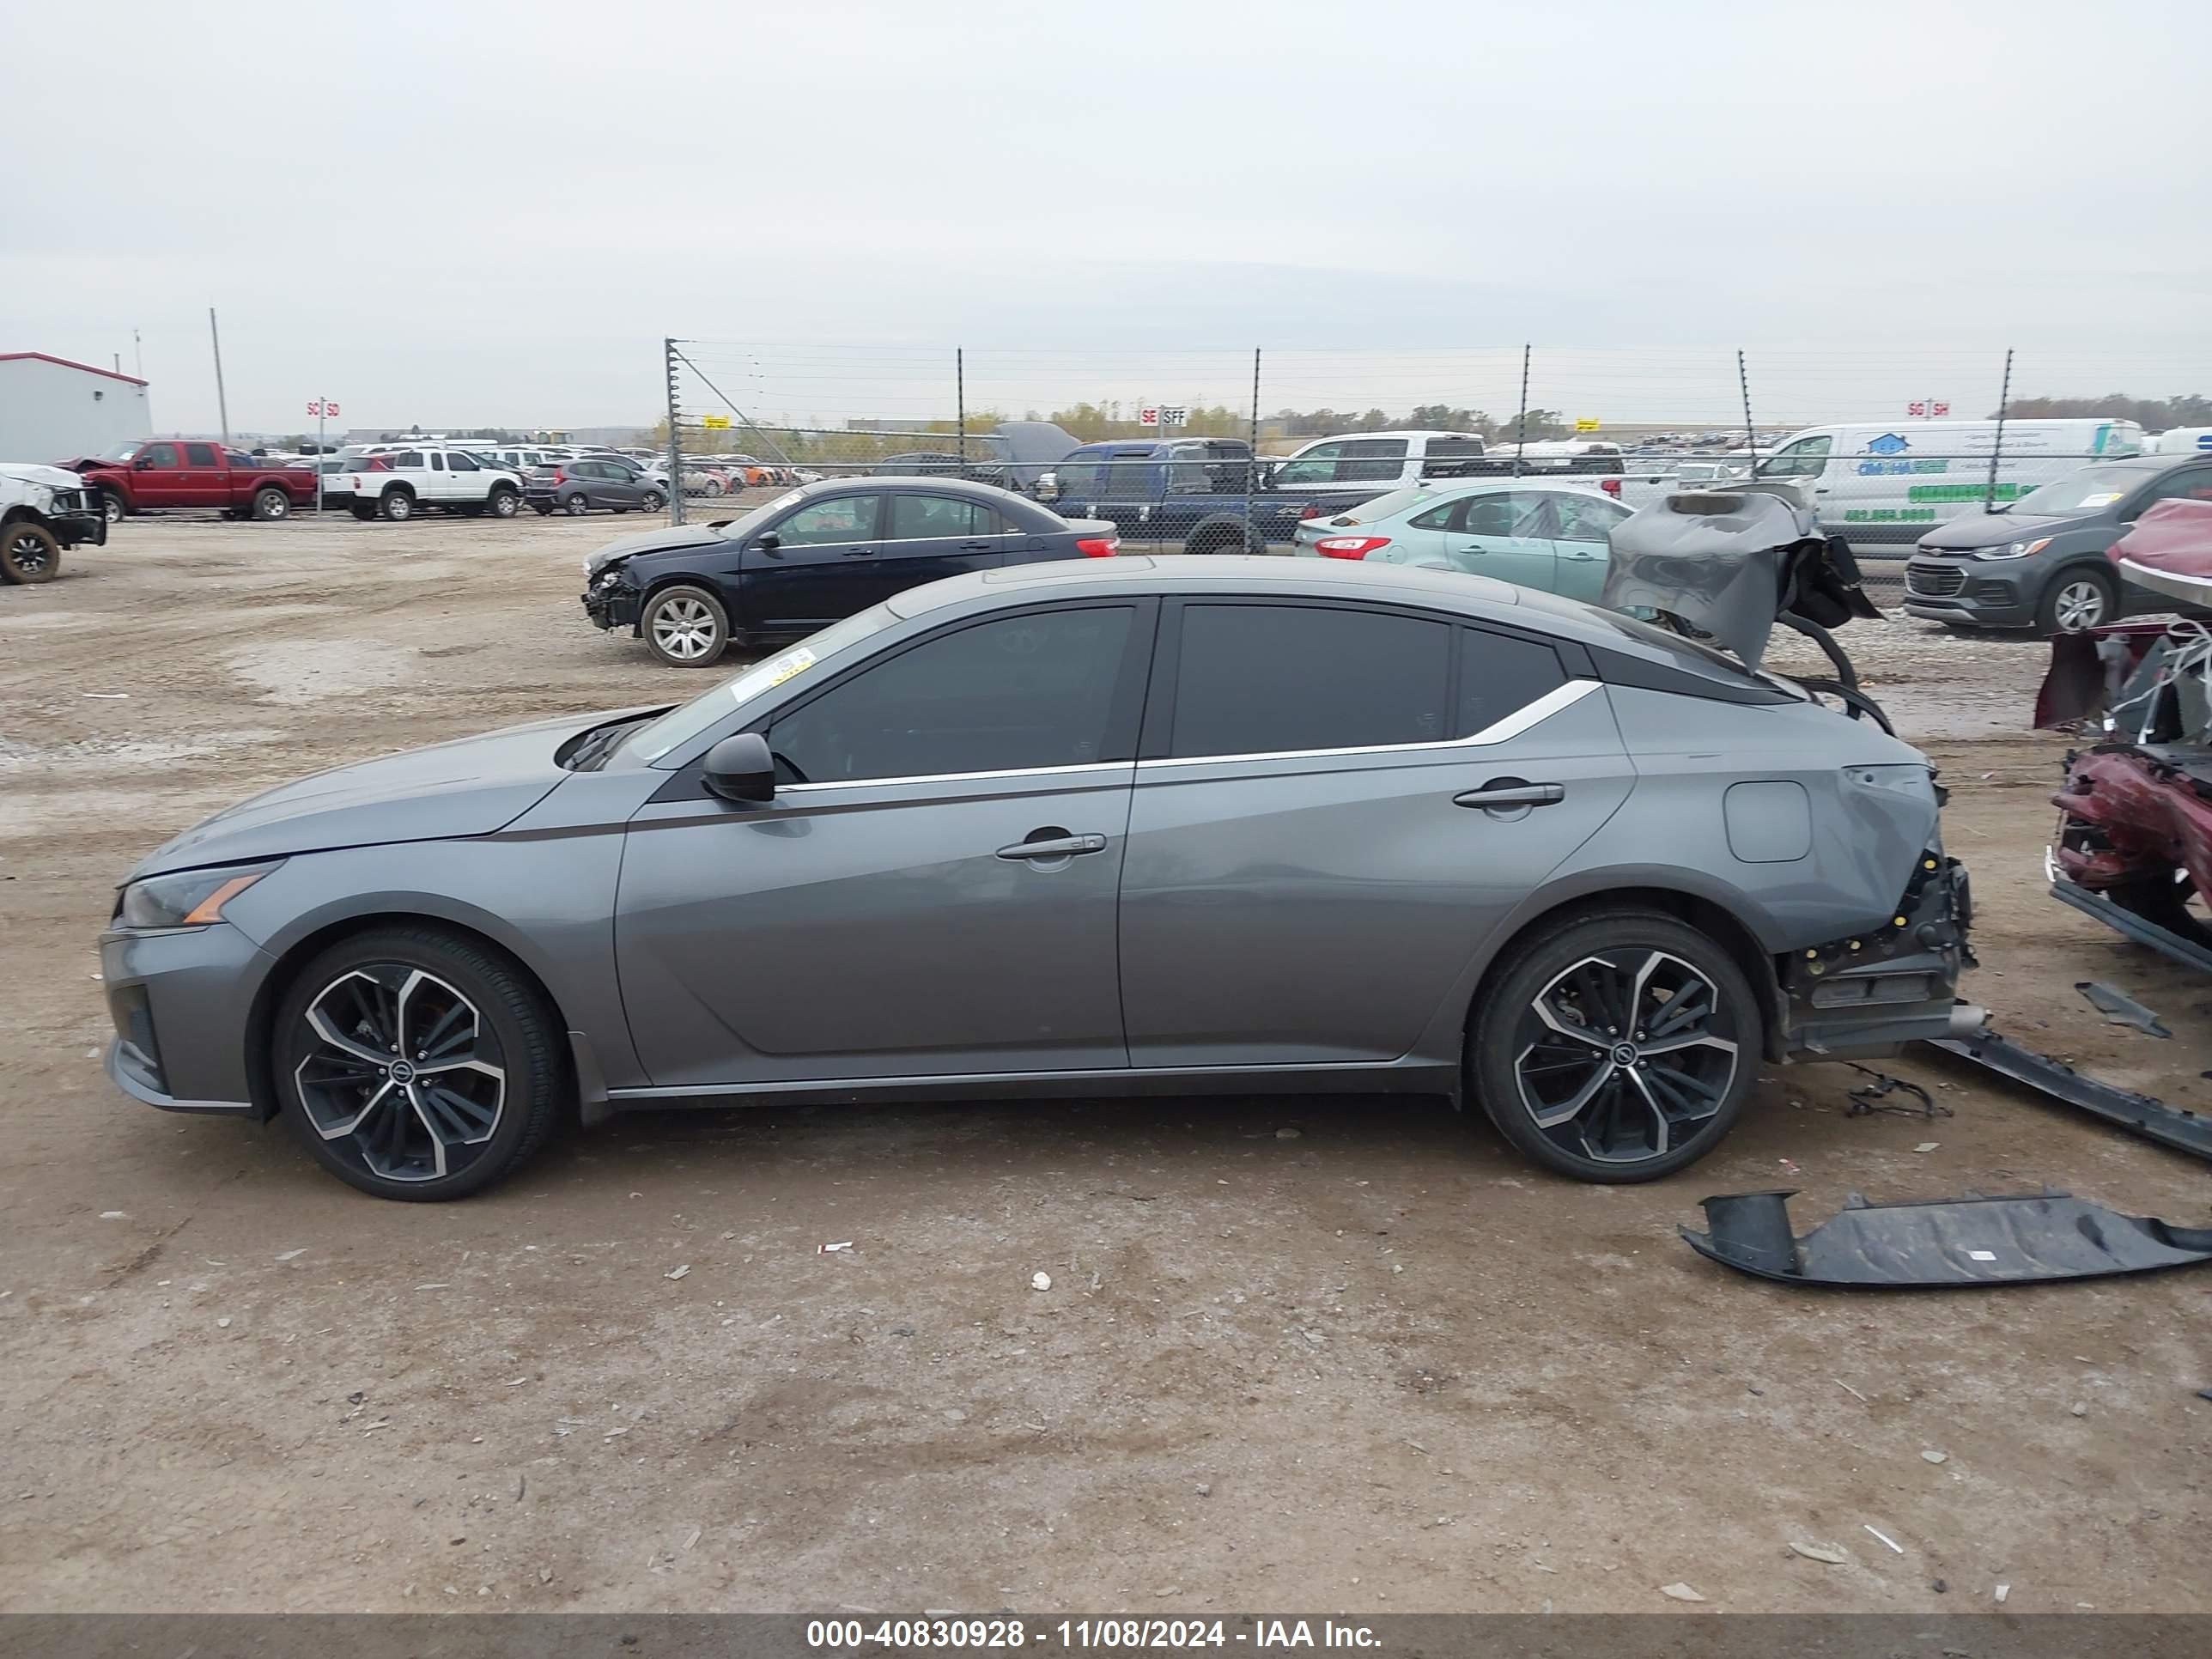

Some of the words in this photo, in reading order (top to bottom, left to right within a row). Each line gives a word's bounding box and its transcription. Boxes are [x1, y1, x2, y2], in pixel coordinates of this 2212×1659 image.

[327, 403, 340, 416] SD
[1141, 409, 1157, 423] SE
[1908, 403, 1924, 416] SG
[1163, 410, 1186, 424] SFF
